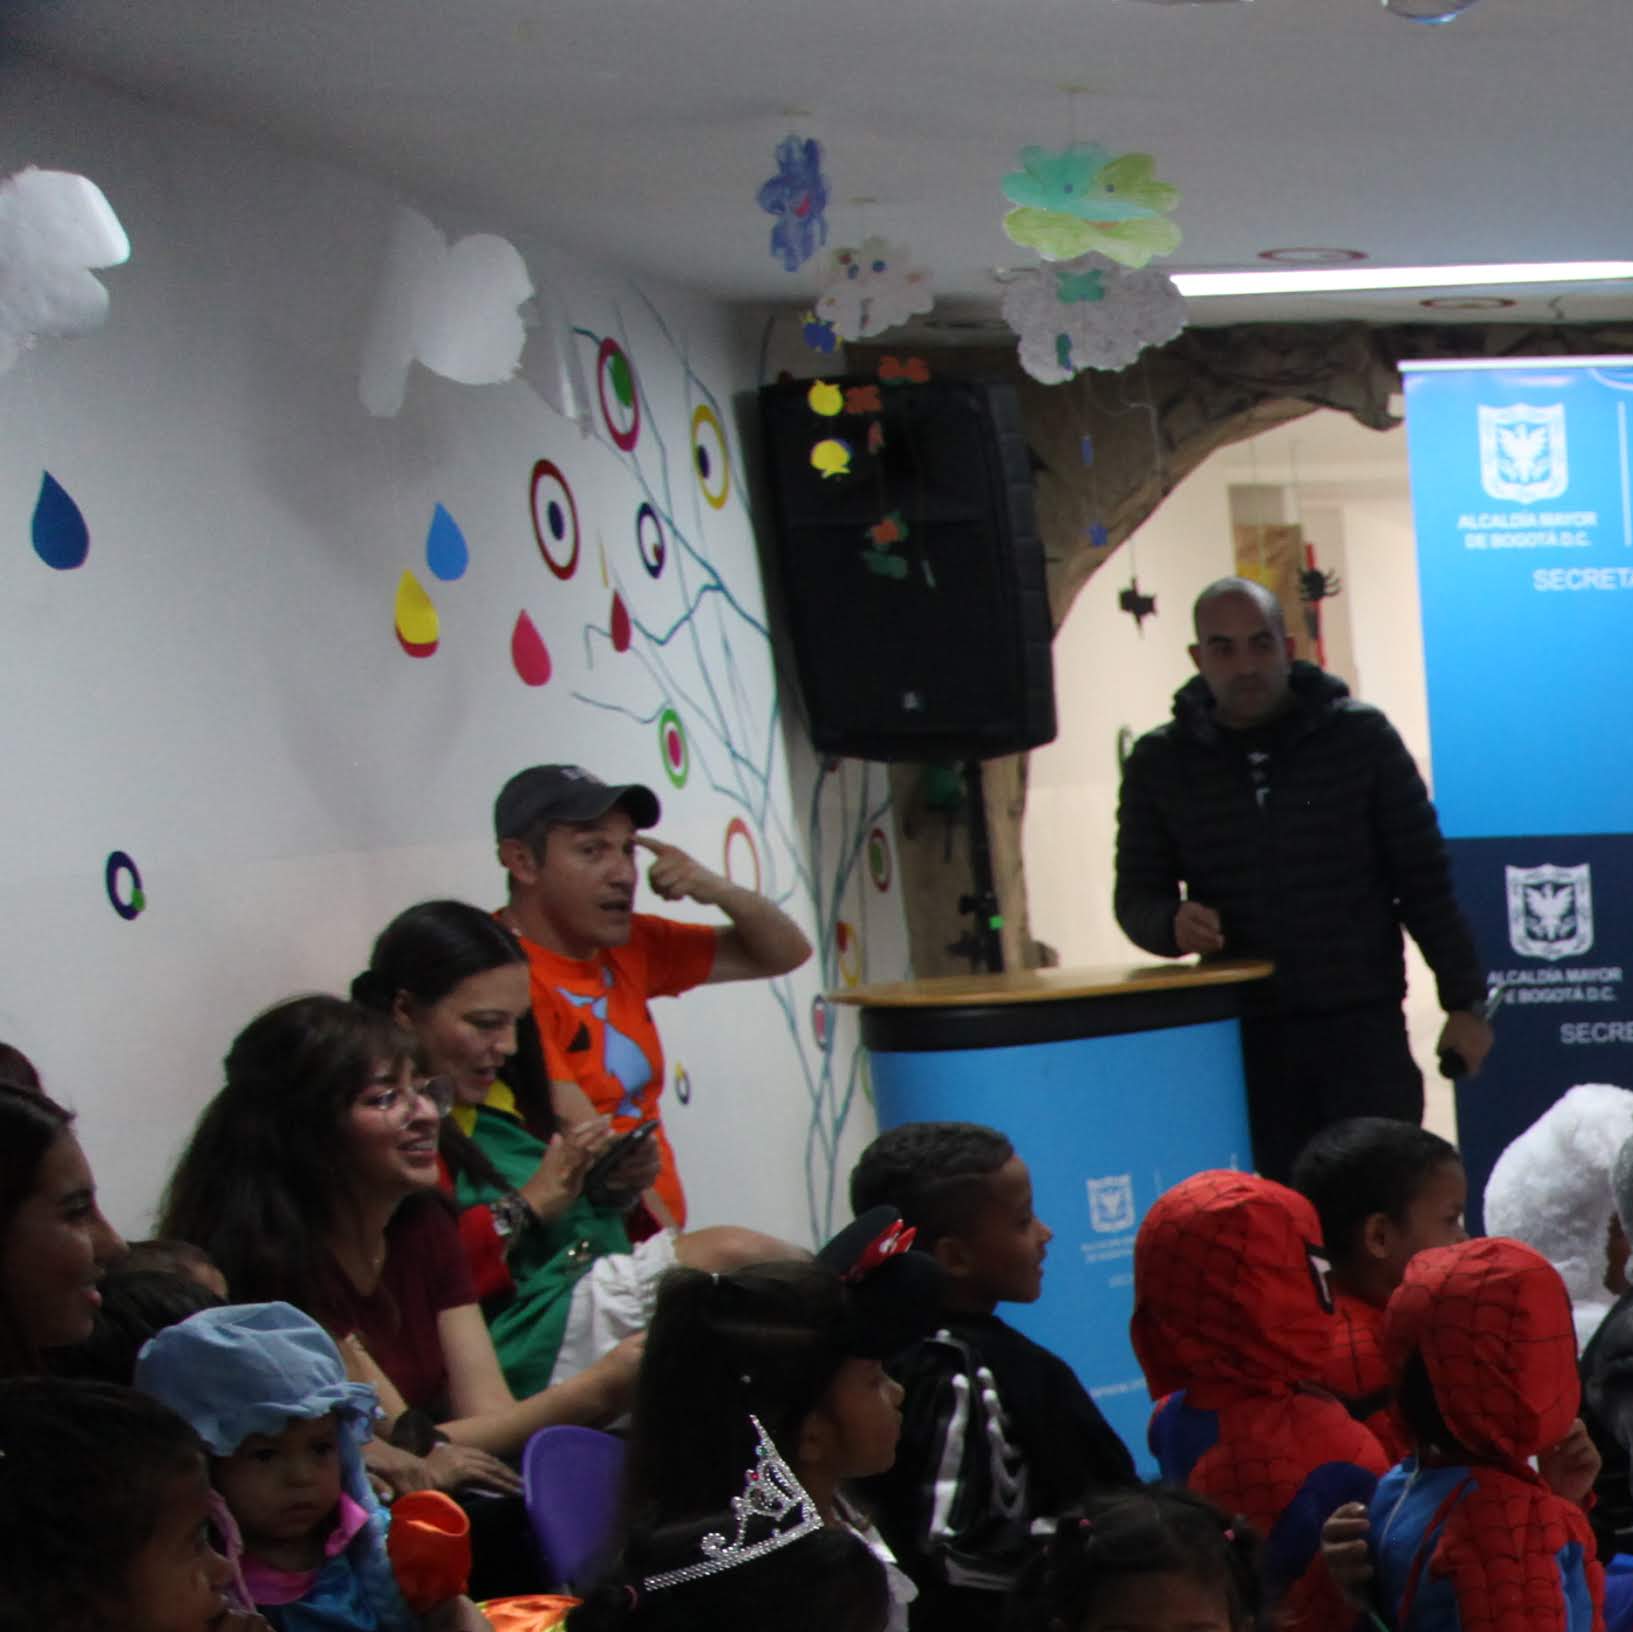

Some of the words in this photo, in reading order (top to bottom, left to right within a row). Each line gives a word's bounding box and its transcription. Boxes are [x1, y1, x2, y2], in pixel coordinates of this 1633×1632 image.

[1487, 969, 1563, 985] ALCALDÍA
[1566, 967, 1623, 982] MAYOR
[1518, 986, 1585, 1003] BOGOTÁ
